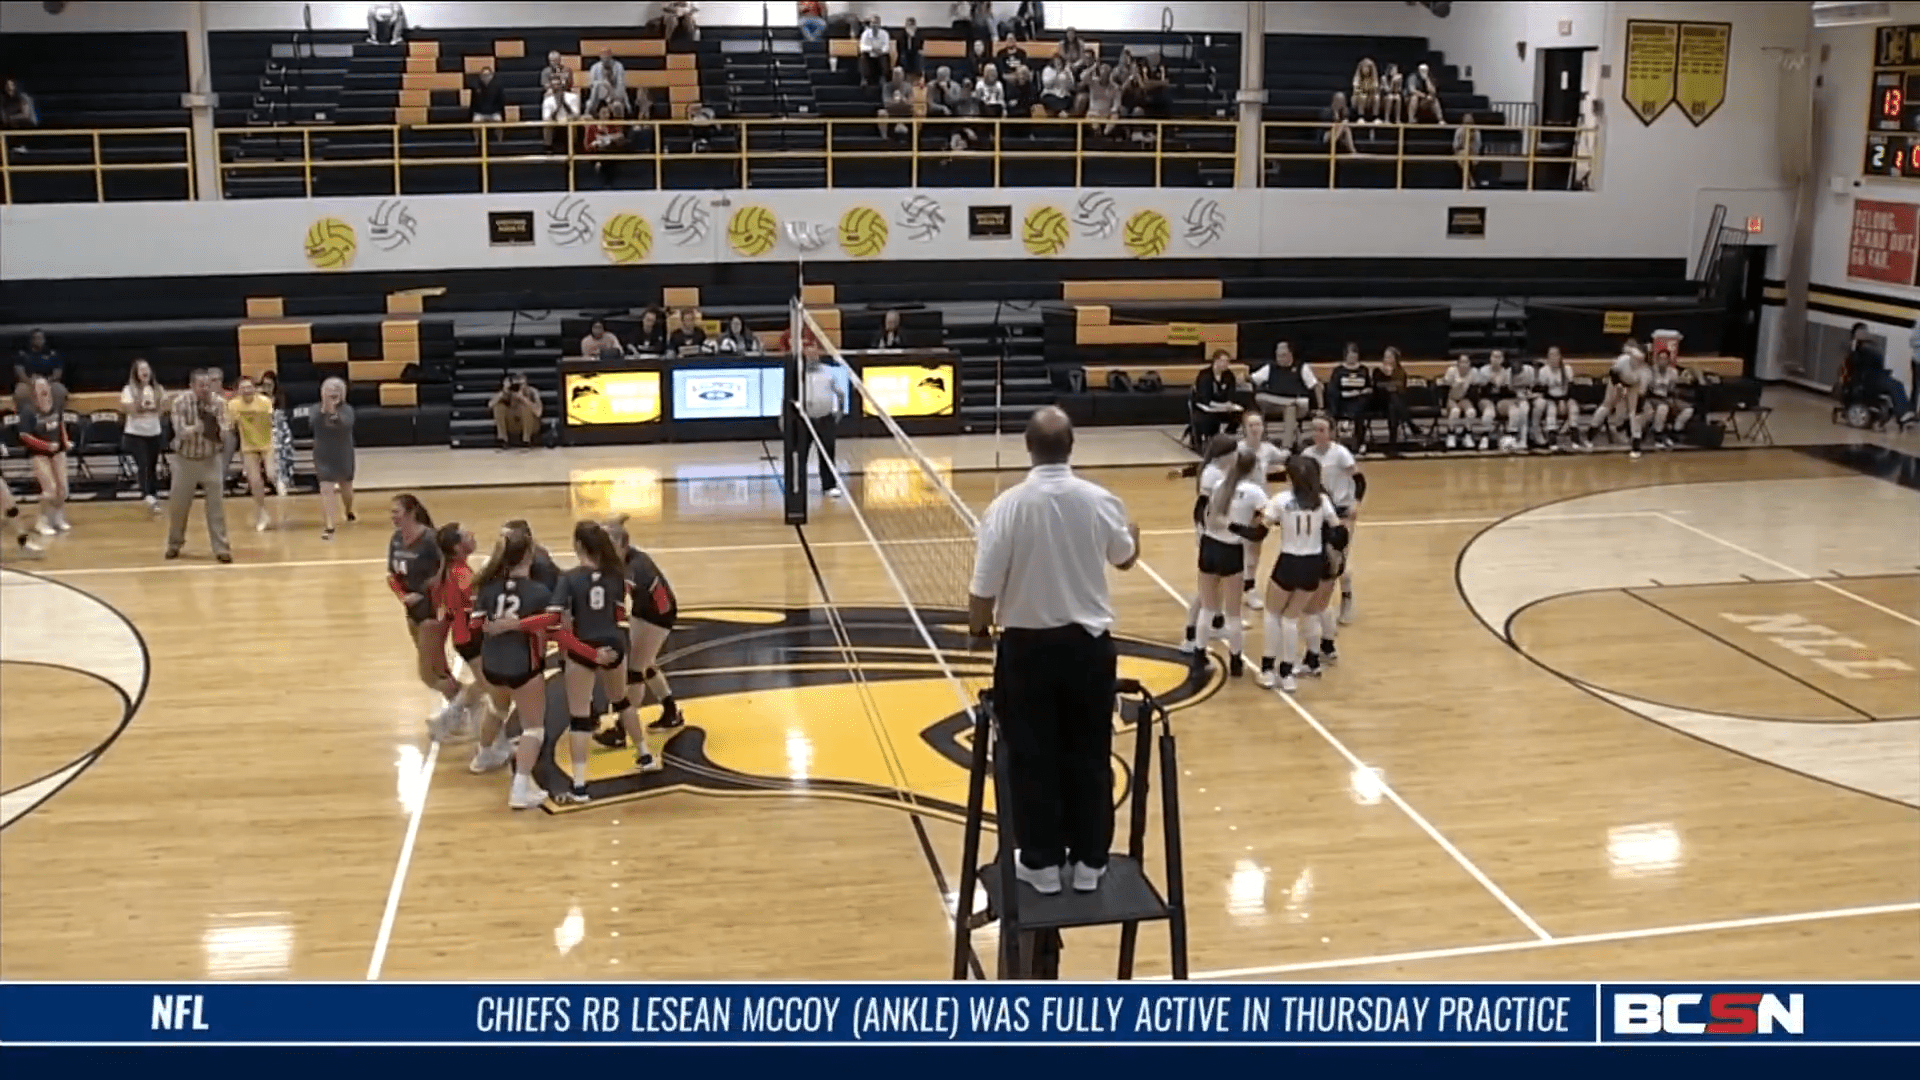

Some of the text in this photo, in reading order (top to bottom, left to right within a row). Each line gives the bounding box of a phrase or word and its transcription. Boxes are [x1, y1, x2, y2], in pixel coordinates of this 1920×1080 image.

[1884, 88, 1902, 117] 13
[1872, 145, 1886, 168] 2
[1296, 514, 1312, 537] 11
[496, 593, 520, 619] 12
